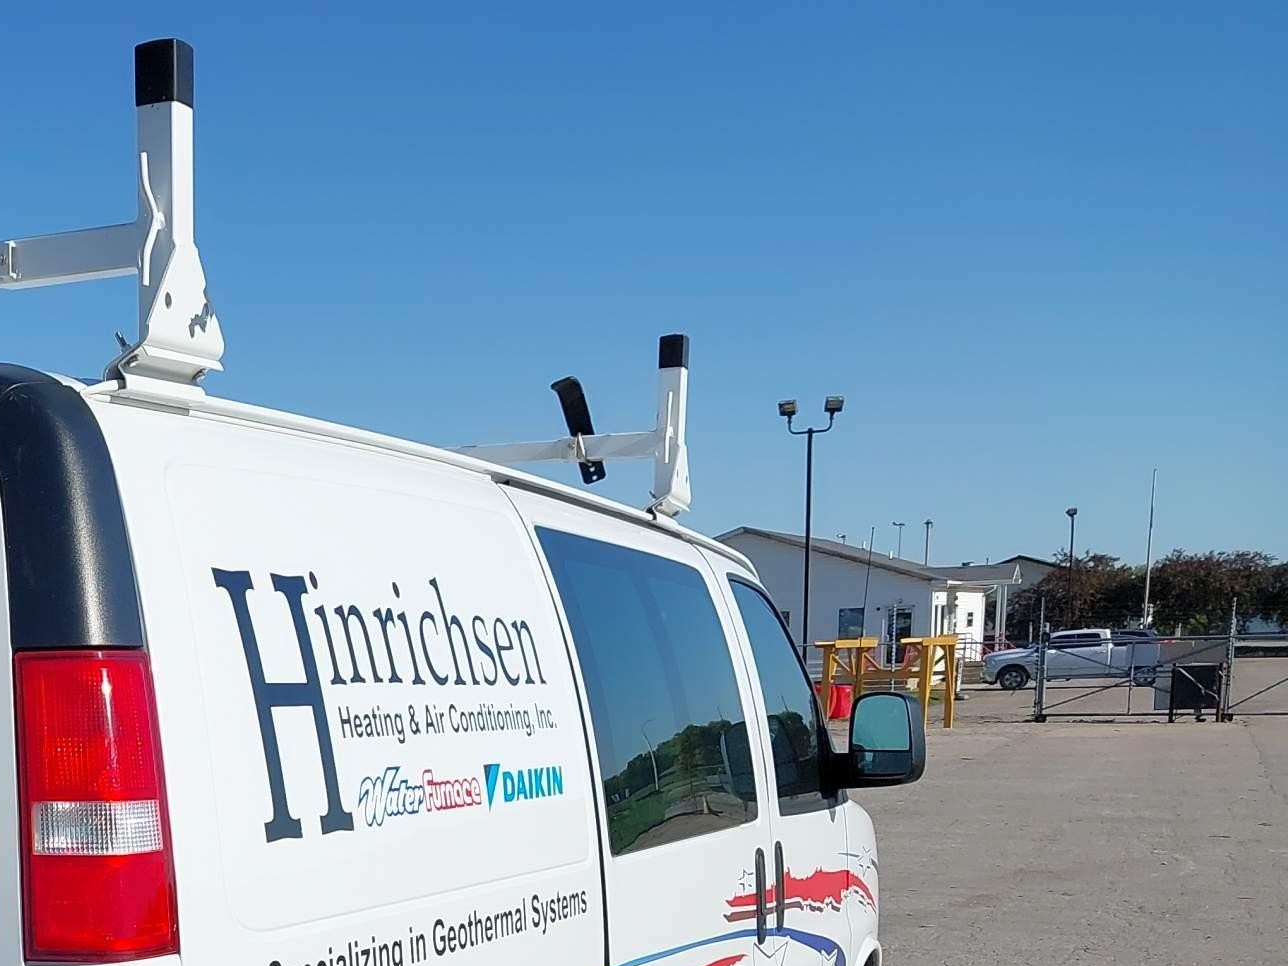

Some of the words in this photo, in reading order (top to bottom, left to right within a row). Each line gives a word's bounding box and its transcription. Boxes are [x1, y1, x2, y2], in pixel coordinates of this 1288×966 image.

[211, 567, 548, 844] Hinrichsen
[338, 705, 406, 744] Heating
[408, 704, 422, 736] &
[425, 704, 446, 735] Air
[448, 702, 535, 737] Conditioning,
[534, 702, 558, 730] Inc.
[502, 765, 564, 803] DAIKIN
[409, 926, 427, 965] in
[432, 898, 528, 957] Geothermal
[531, 889, 588, 935] Systems
